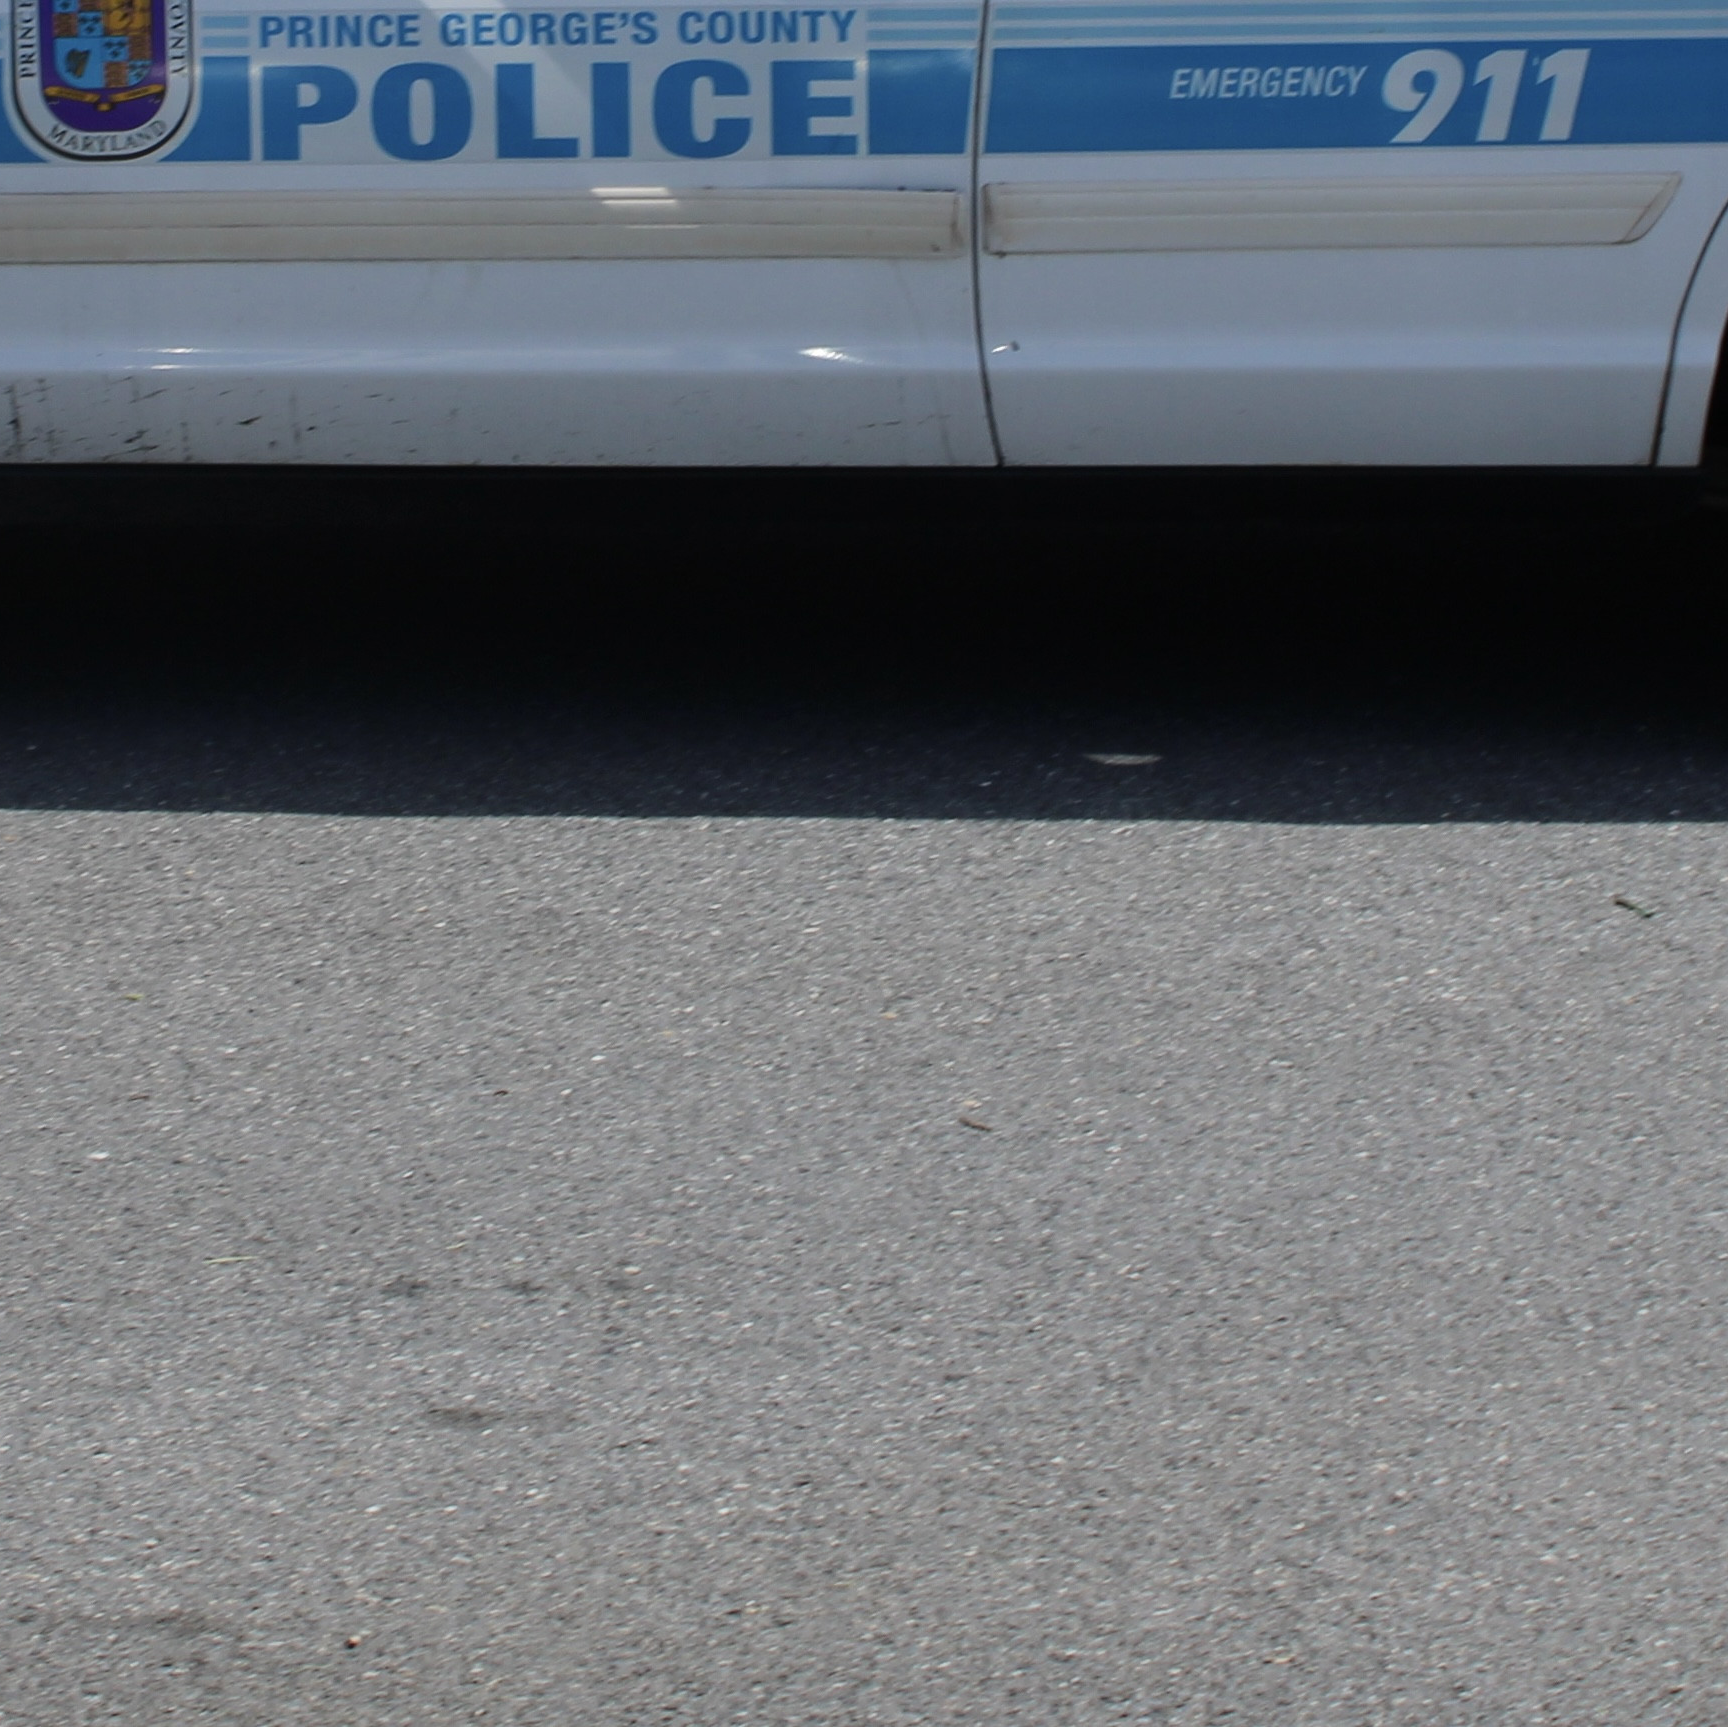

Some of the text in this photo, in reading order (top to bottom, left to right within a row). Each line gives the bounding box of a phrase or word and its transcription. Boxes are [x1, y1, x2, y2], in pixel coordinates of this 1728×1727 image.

[259, 9, 857, 48] PRINCE GEORGE'S COUNTY
[261, 58, 859, 162] POLICE
[1169, 48, 1592, 143] EMERGENCY 911
[48, 121, 167, 153] MARYLAND
